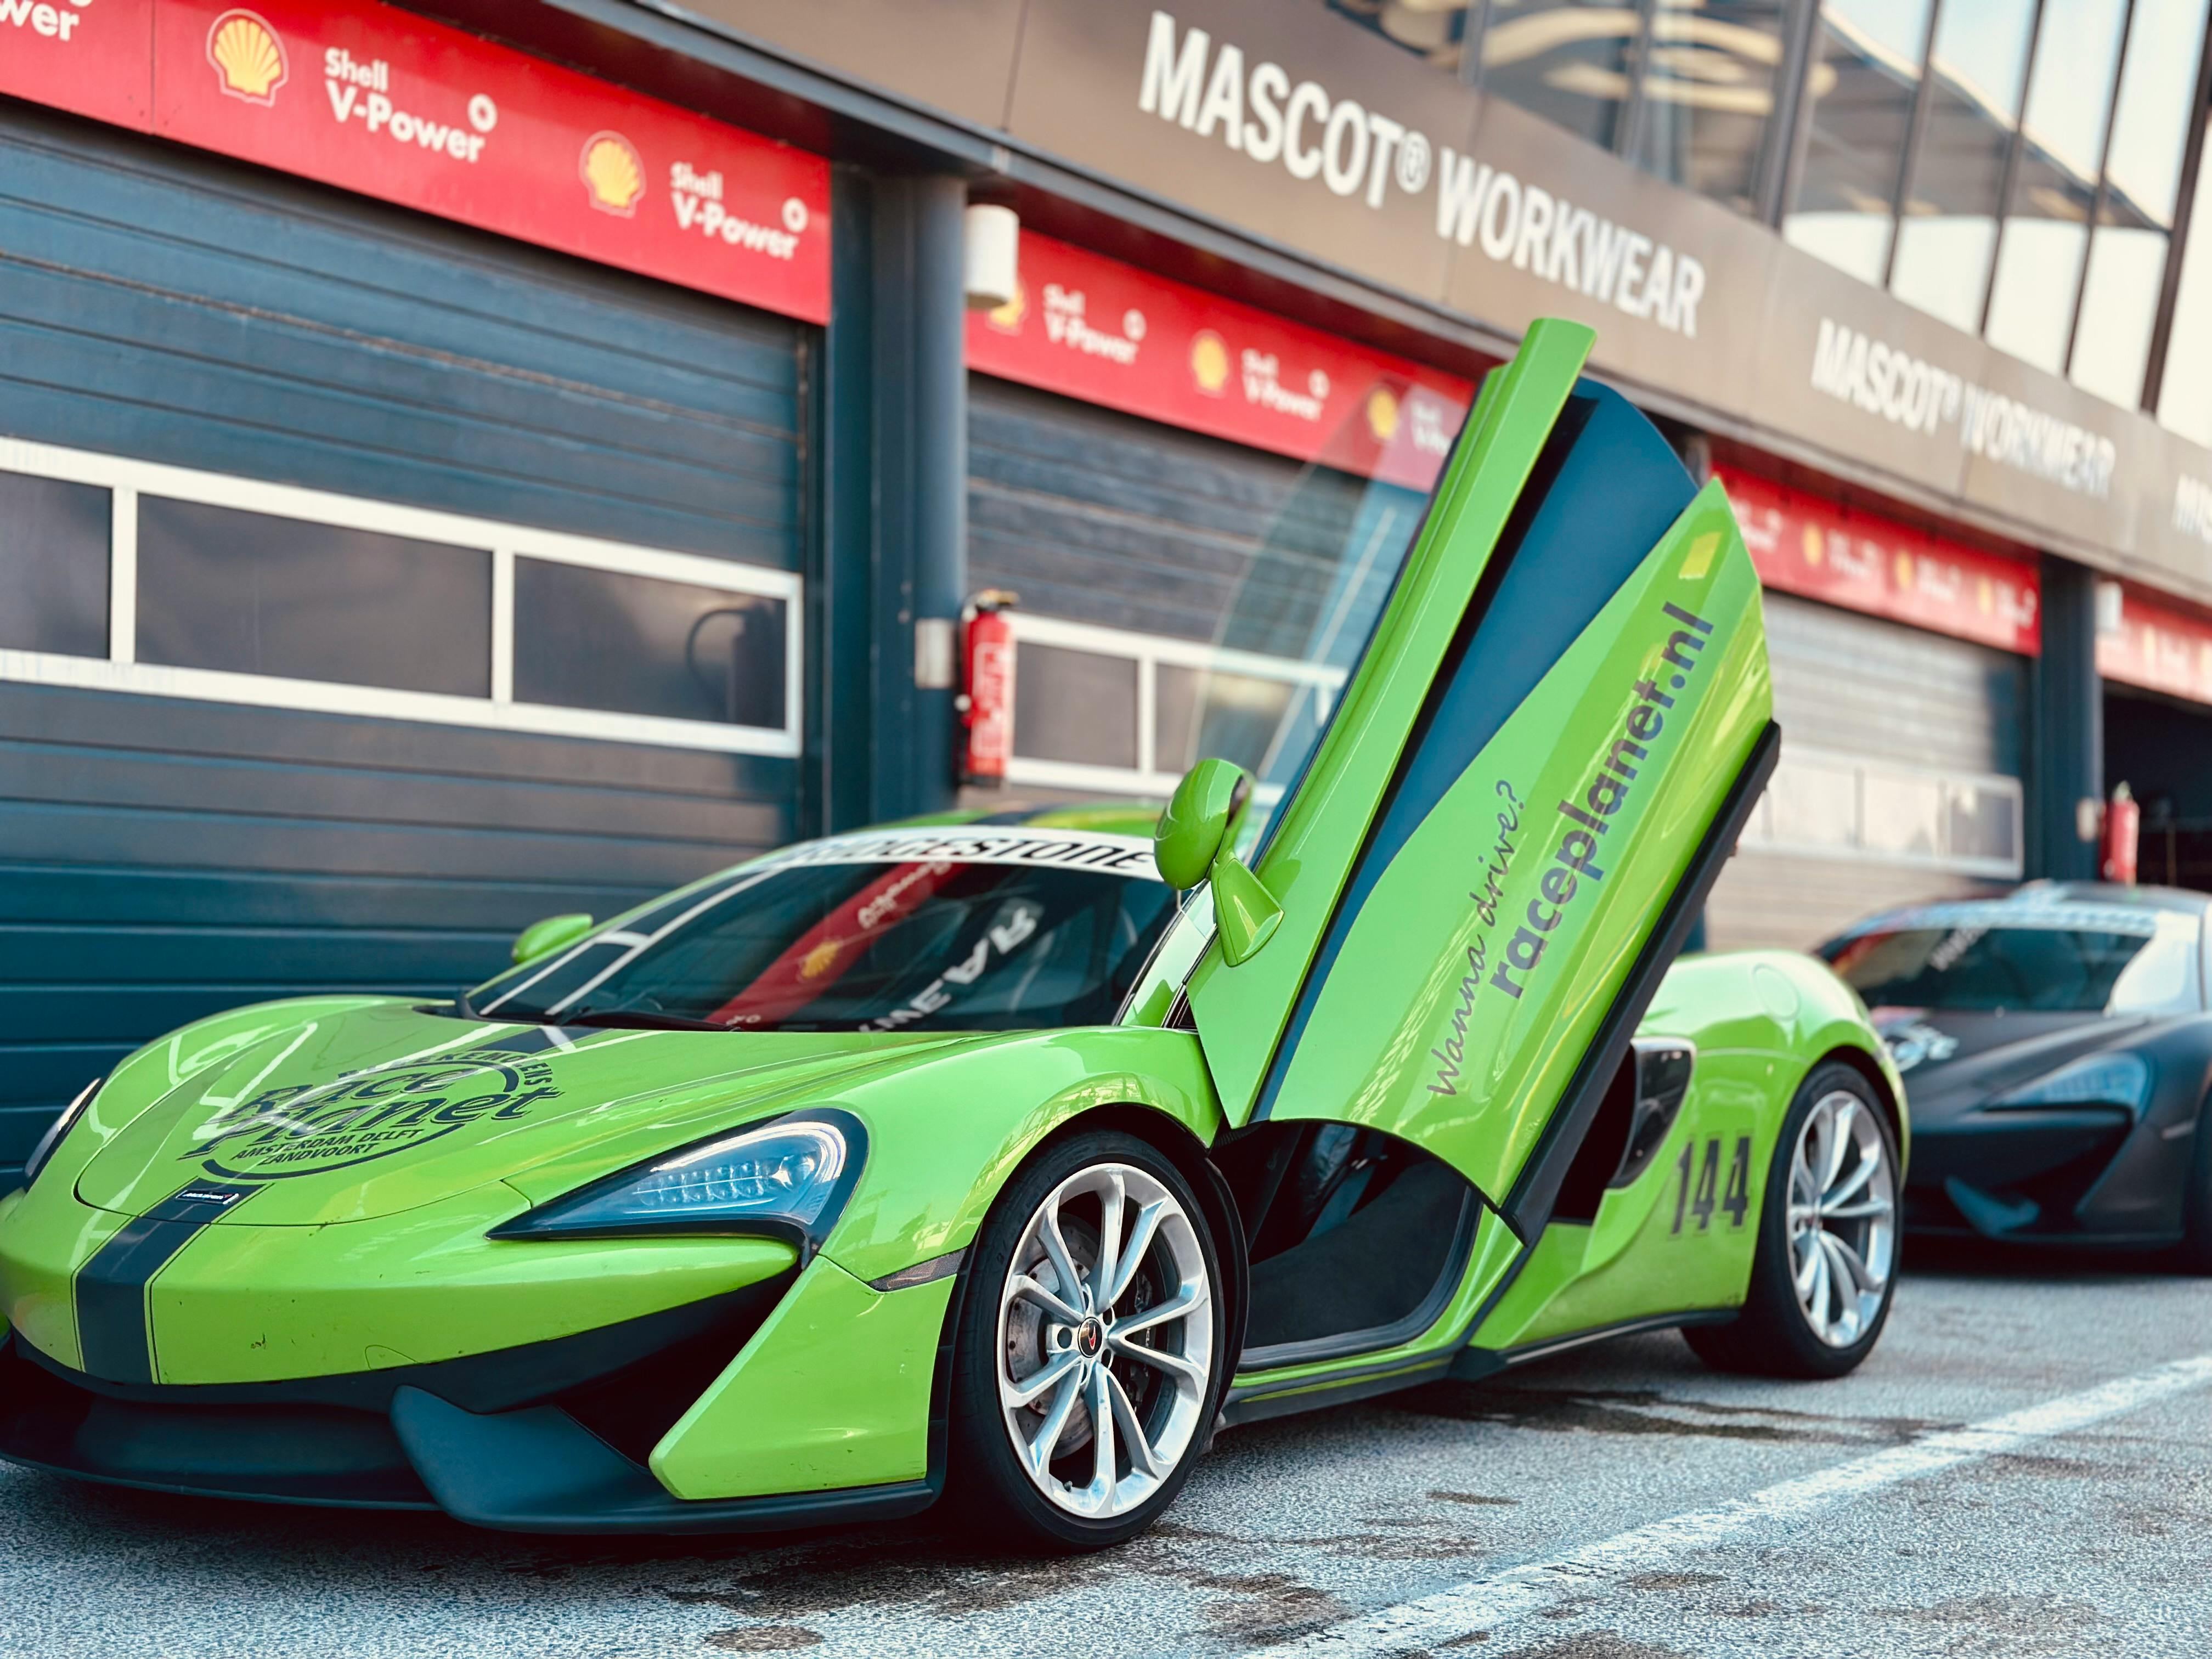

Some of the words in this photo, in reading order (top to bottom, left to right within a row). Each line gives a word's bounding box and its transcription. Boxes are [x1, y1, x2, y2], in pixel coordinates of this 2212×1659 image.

[325, 48, 388, 92] Shell
[325, 79, 486, 162] V-Power
[670, 192, 799, 260] V-Power
[1435, 146, 1706, 338] WORKWEAR
[1489, 601, 1714, 1000] raceplanet.nl
[1469, 779, 1526, 927] drive?
[229, 1135, 355, 1161] AMSTERDAM
[357, 1128, 425, 1143] DELFT
[256, 1142, 381, 1166] ZANDVOORT
[1668, 1130, 1753, 1238] 144
